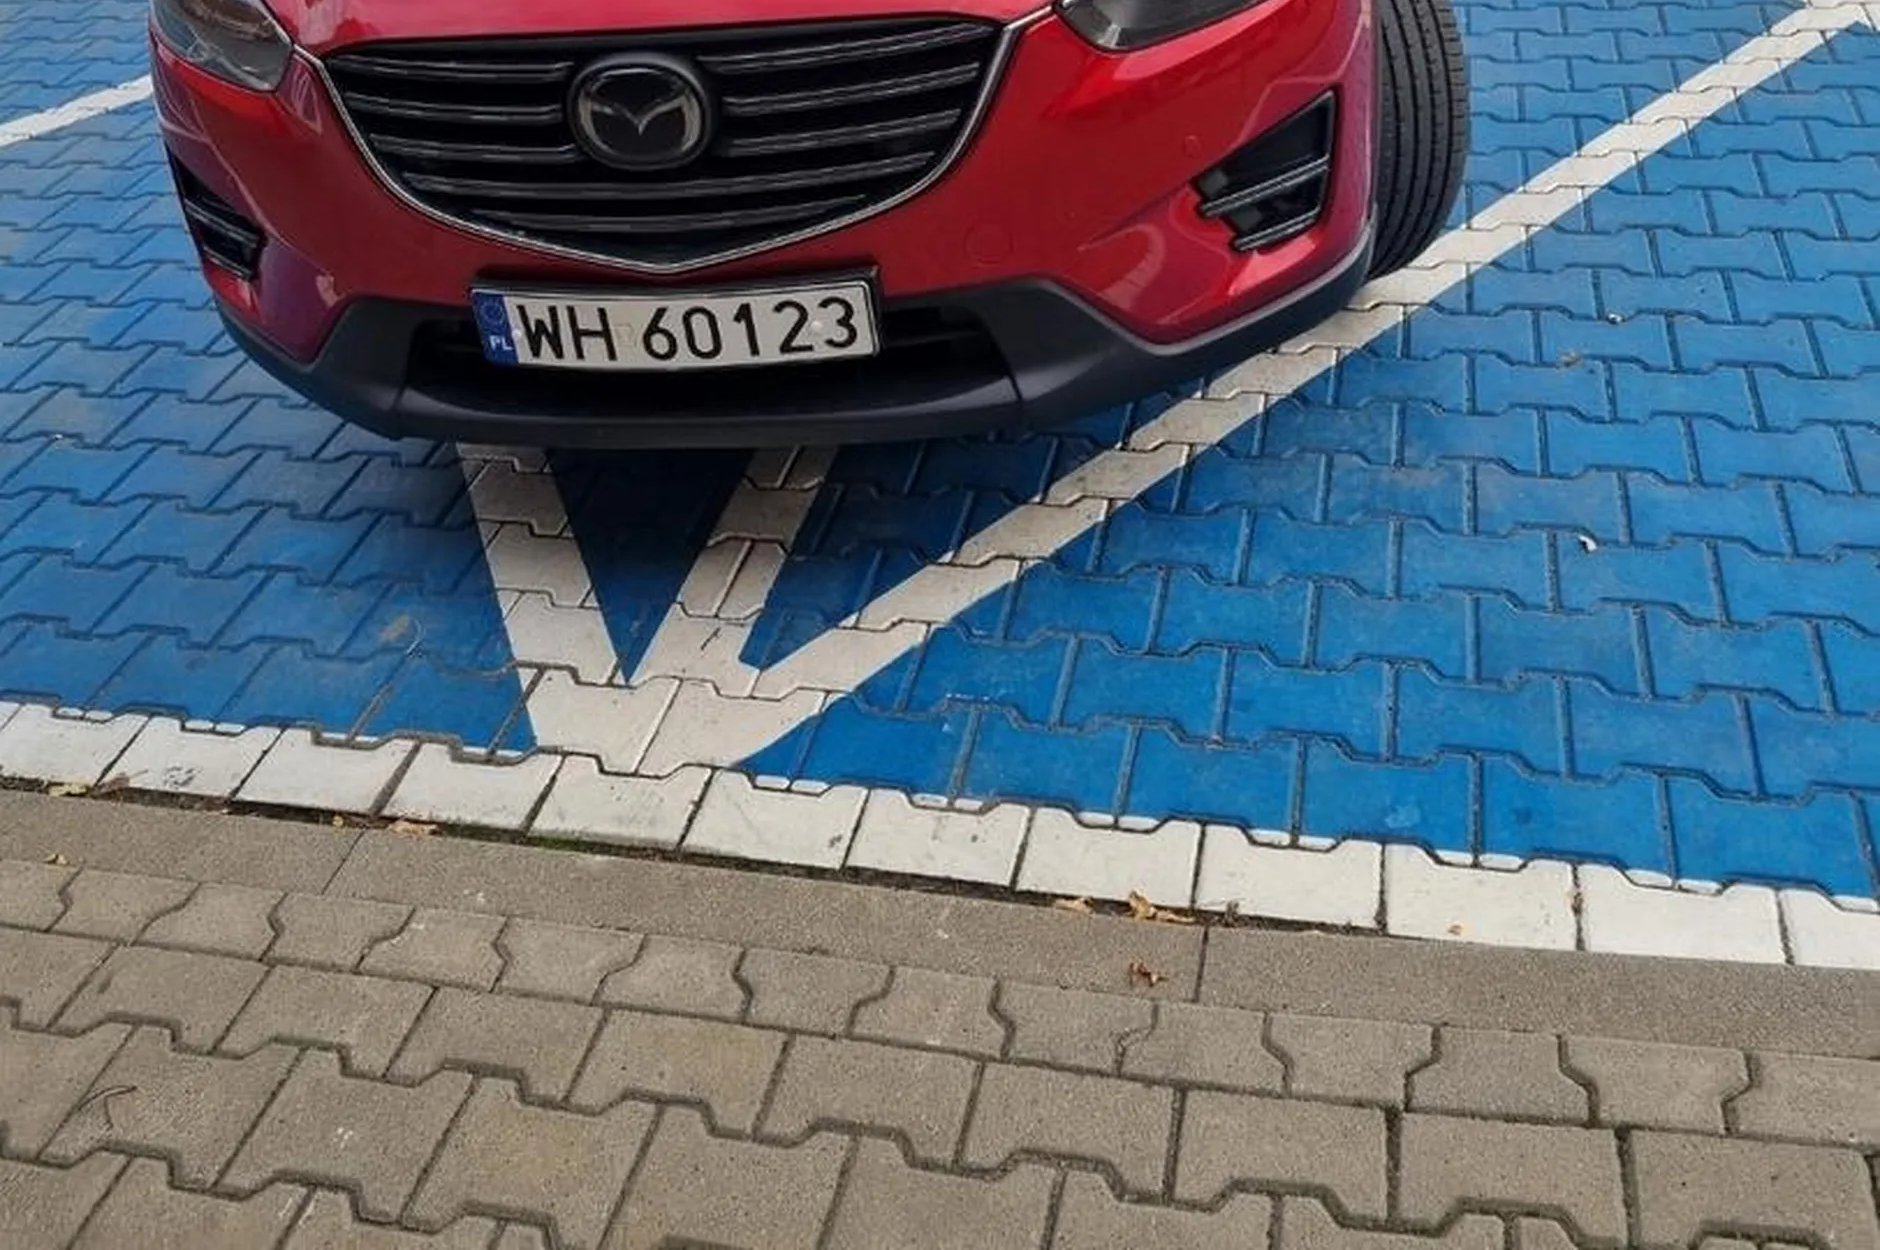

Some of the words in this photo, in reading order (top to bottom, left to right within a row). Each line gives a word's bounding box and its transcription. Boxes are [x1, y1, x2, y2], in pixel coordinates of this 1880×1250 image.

[489, 335, 513, 352] PL
[516, 304, 619, 361] WH
[641, 296, 859, 361] 60123
